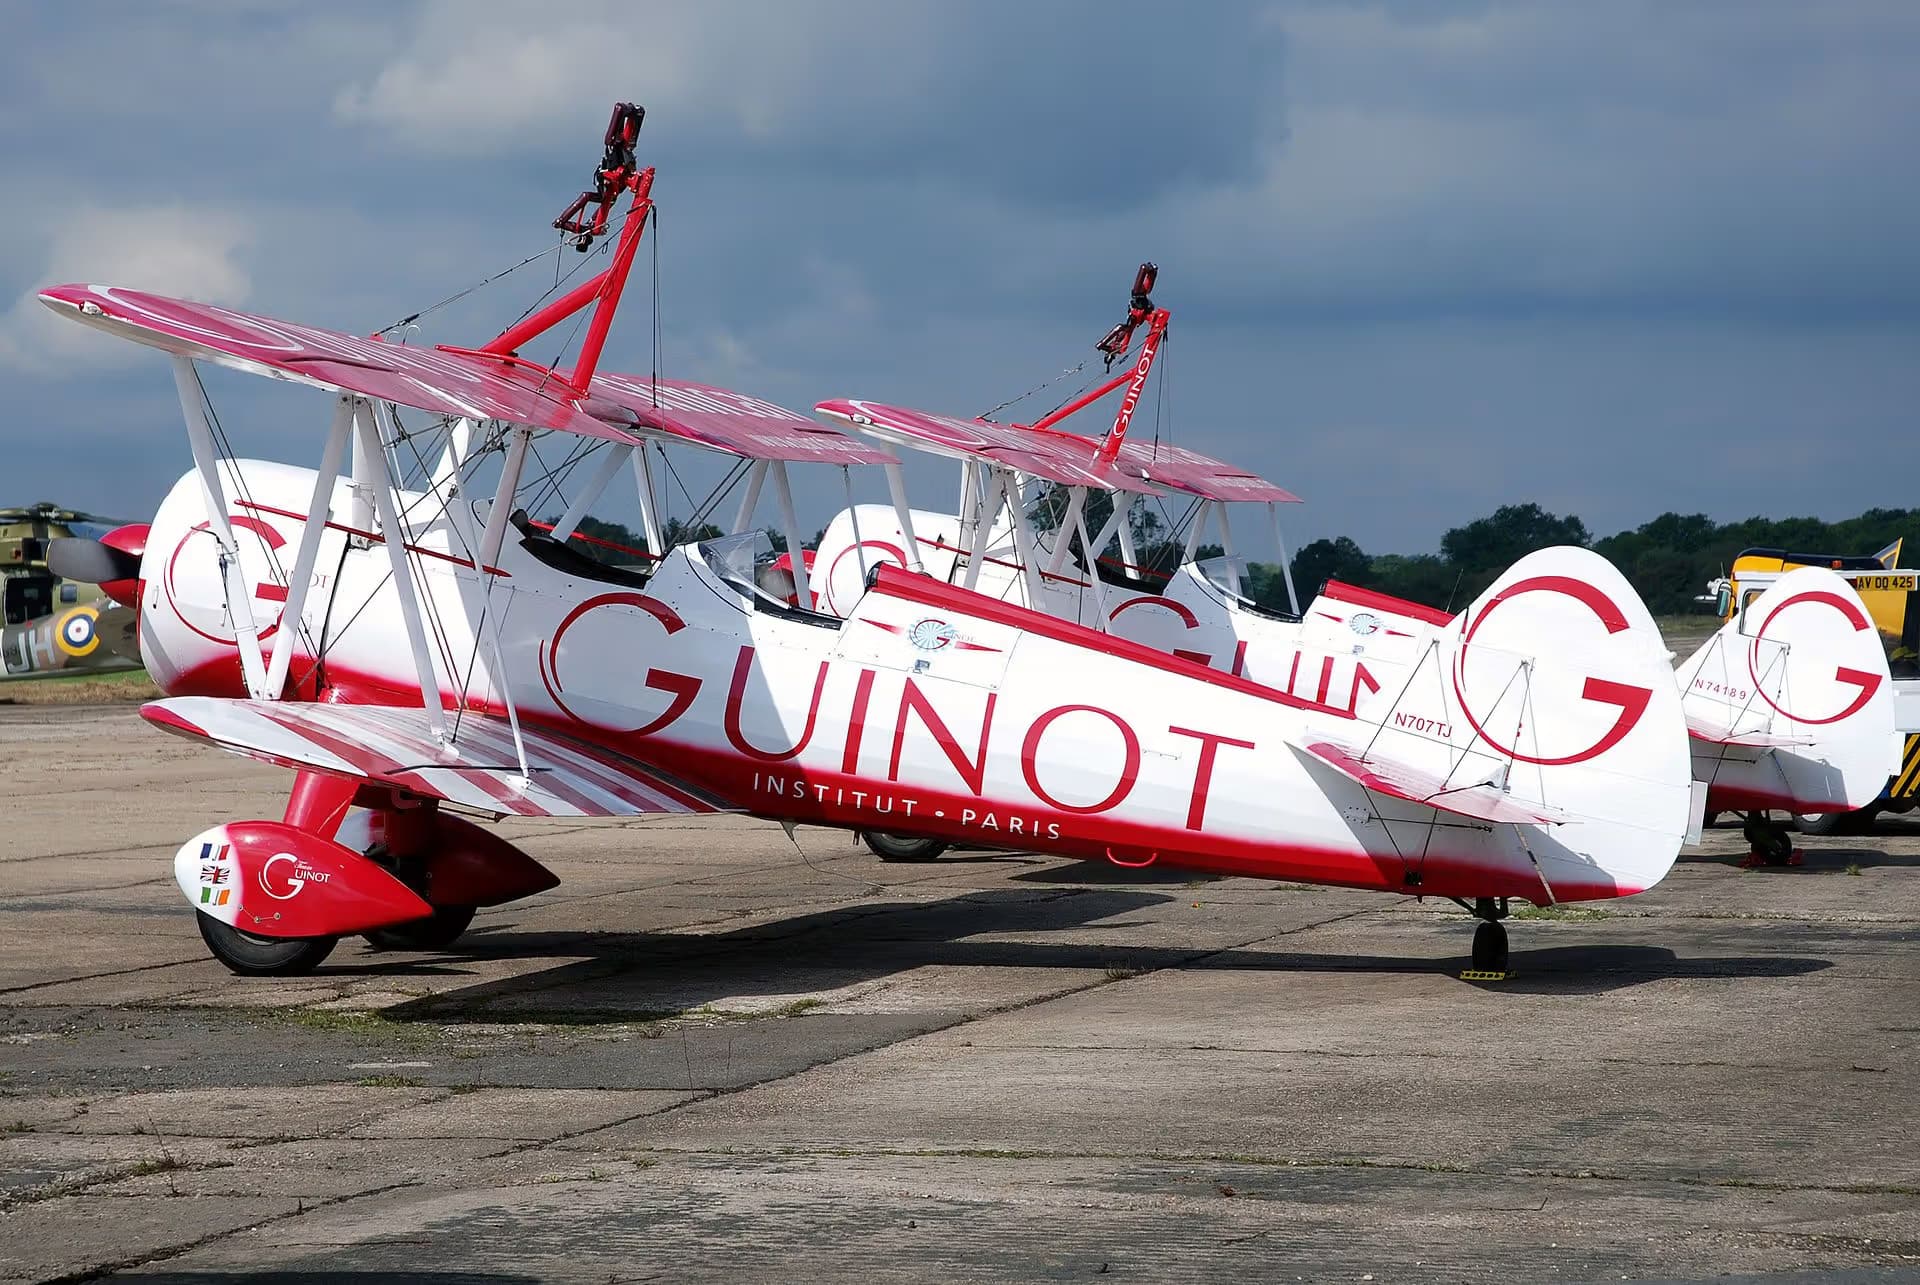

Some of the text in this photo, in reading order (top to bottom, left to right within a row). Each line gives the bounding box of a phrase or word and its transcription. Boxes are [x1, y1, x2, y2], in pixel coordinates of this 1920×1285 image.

[1114, 344, 1154, 438] GUINOT
[538, 592, 1255, 832] GUINOT
[1453, 576, 1653, 765] G
[1749, 591, 1883, 724] G
[1395, 712, 1452, 738] N707TJ
[753, 773, 1061, 840] INSTITUT PARIS
